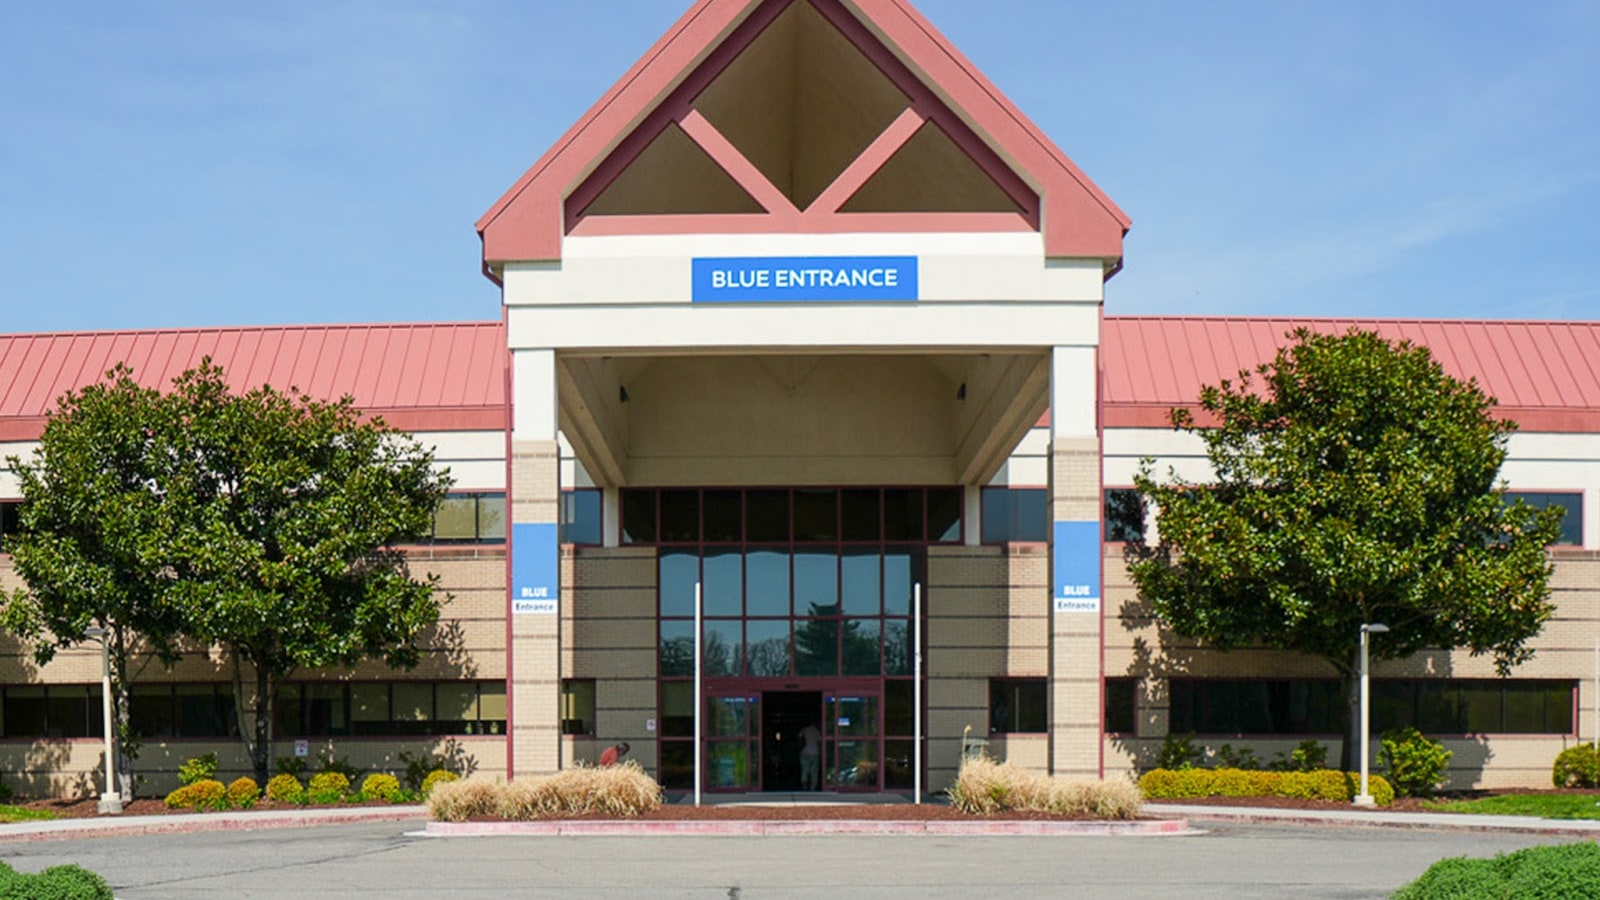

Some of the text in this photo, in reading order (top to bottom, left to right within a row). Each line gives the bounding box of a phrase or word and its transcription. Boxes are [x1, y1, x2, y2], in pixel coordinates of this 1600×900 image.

[712, 269, 898, 288] BLUE ENTRANCE
[521, 587, 548, 597] BLUE
[1063, 585, 1090, 596] BLUE
[515, 603, 553, 611] Entrance
[1057, 601, 1096, 610] Entrance
